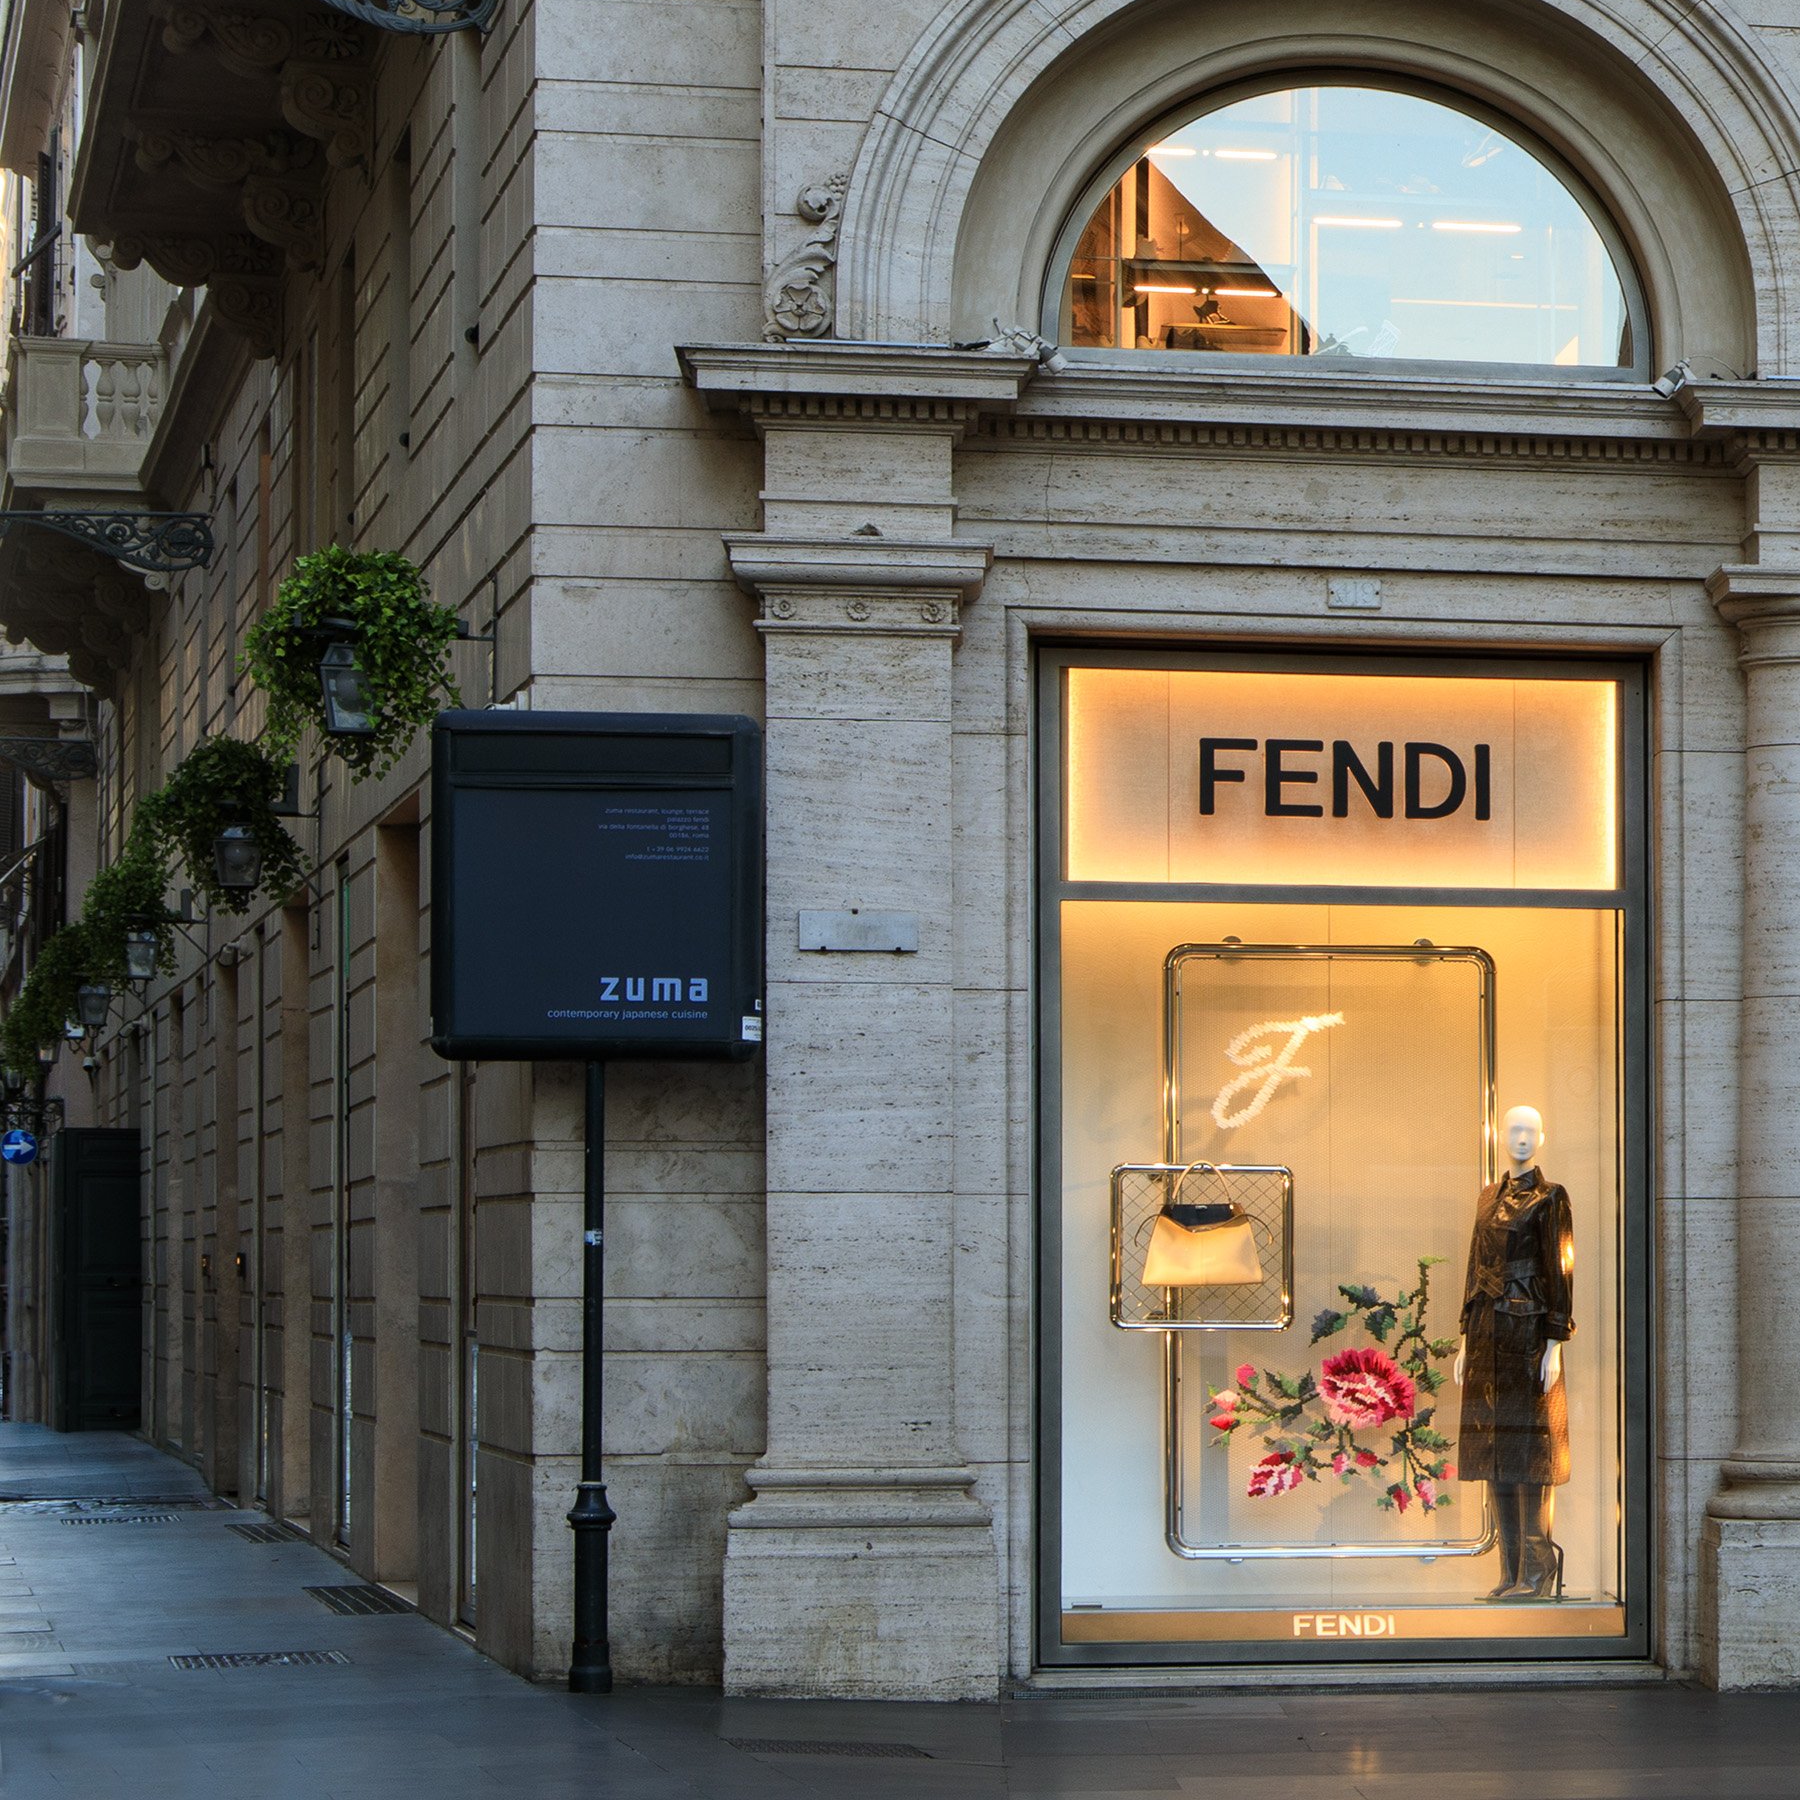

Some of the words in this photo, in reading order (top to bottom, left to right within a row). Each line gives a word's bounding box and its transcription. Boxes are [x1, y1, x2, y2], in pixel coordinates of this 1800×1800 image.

[1199, 736, 1492, 822] FENDI
[600, 977, 708, 1002] zuma
[547, 1009, 620, 1020] contemporary
[621, 1009, 669, 1021] japanese
[671, 1009, 708, 1020] cuisine
[1292, 1613, 1396, 1637] FENDI
